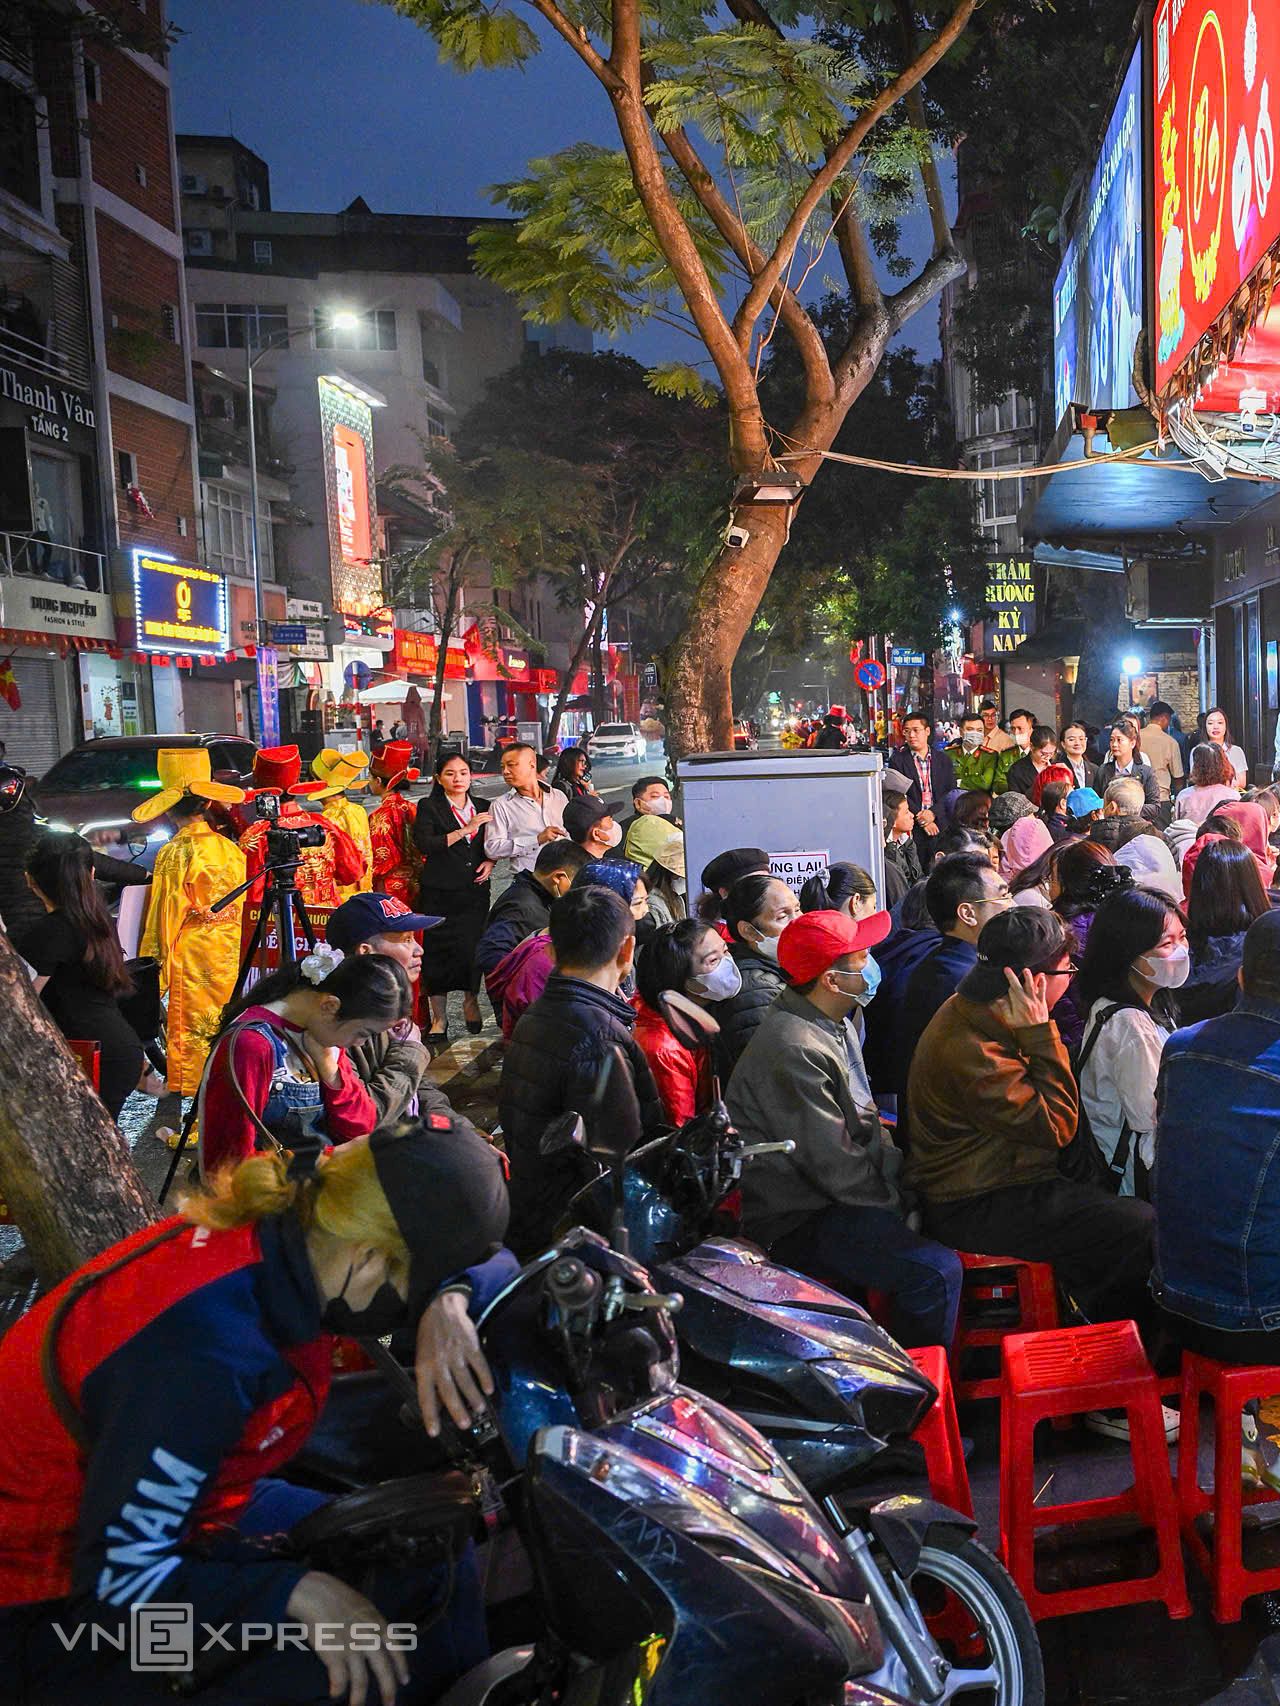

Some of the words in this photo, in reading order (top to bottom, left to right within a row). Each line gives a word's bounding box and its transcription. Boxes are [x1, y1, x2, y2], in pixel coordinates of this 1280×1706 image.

[0, 367, 58, 415] Thanh
[60, 391, 96, 428] Vân
[61, 426, 69, 442] 2
[44, 615, 66, 625] FASHION
[71, 619, 86, 627] STYLE
[998, 606, 1022, 629] KỲ
